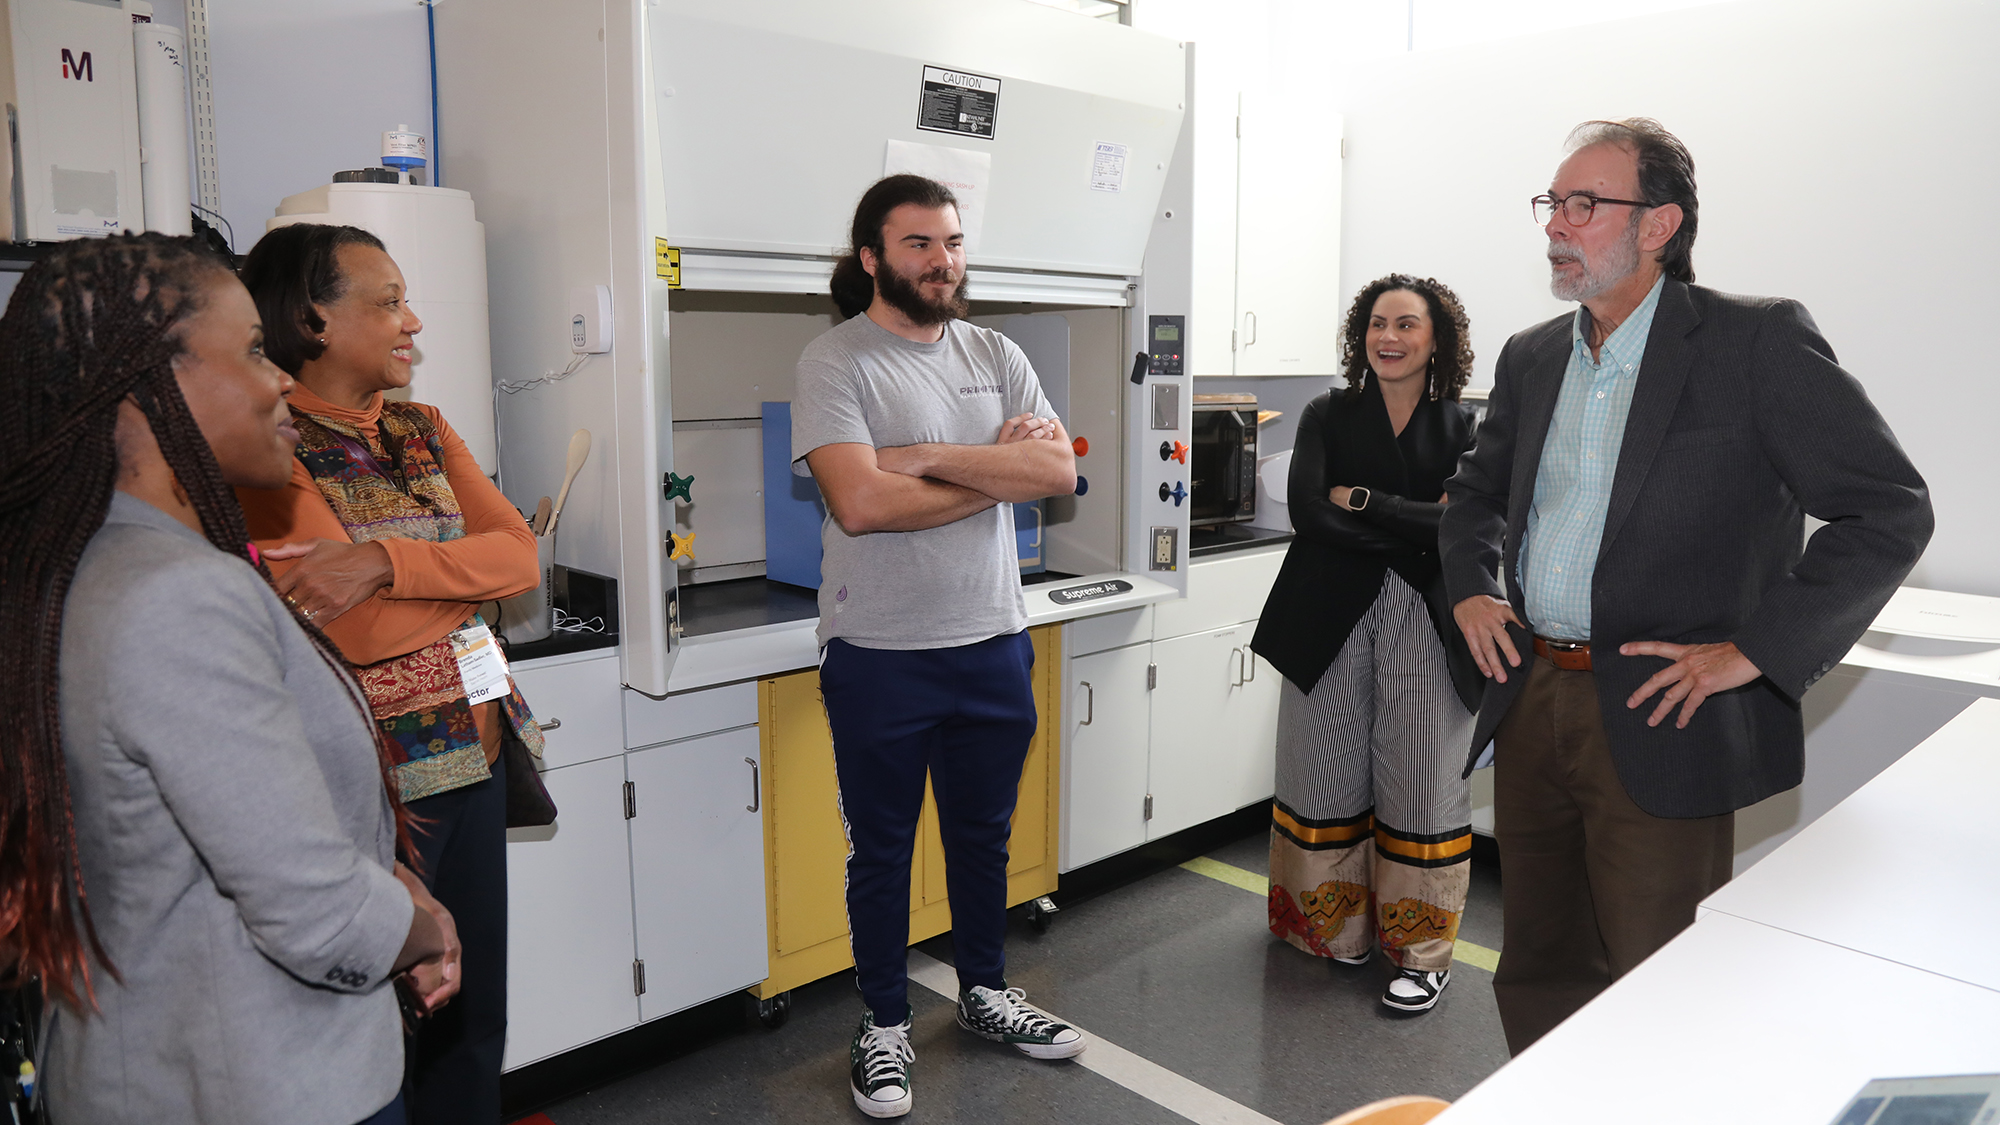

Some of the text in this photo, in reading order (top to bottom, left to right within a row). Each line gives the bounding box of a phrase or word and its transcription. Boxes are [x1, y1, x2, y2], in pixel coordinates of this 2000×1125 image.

[942, 72, 982, 88] CAUTION
[1062, 586, 1105, 599] Supreme
[1104, 583, 1118, 592] Air
[467, 687, 489, 700] octor
